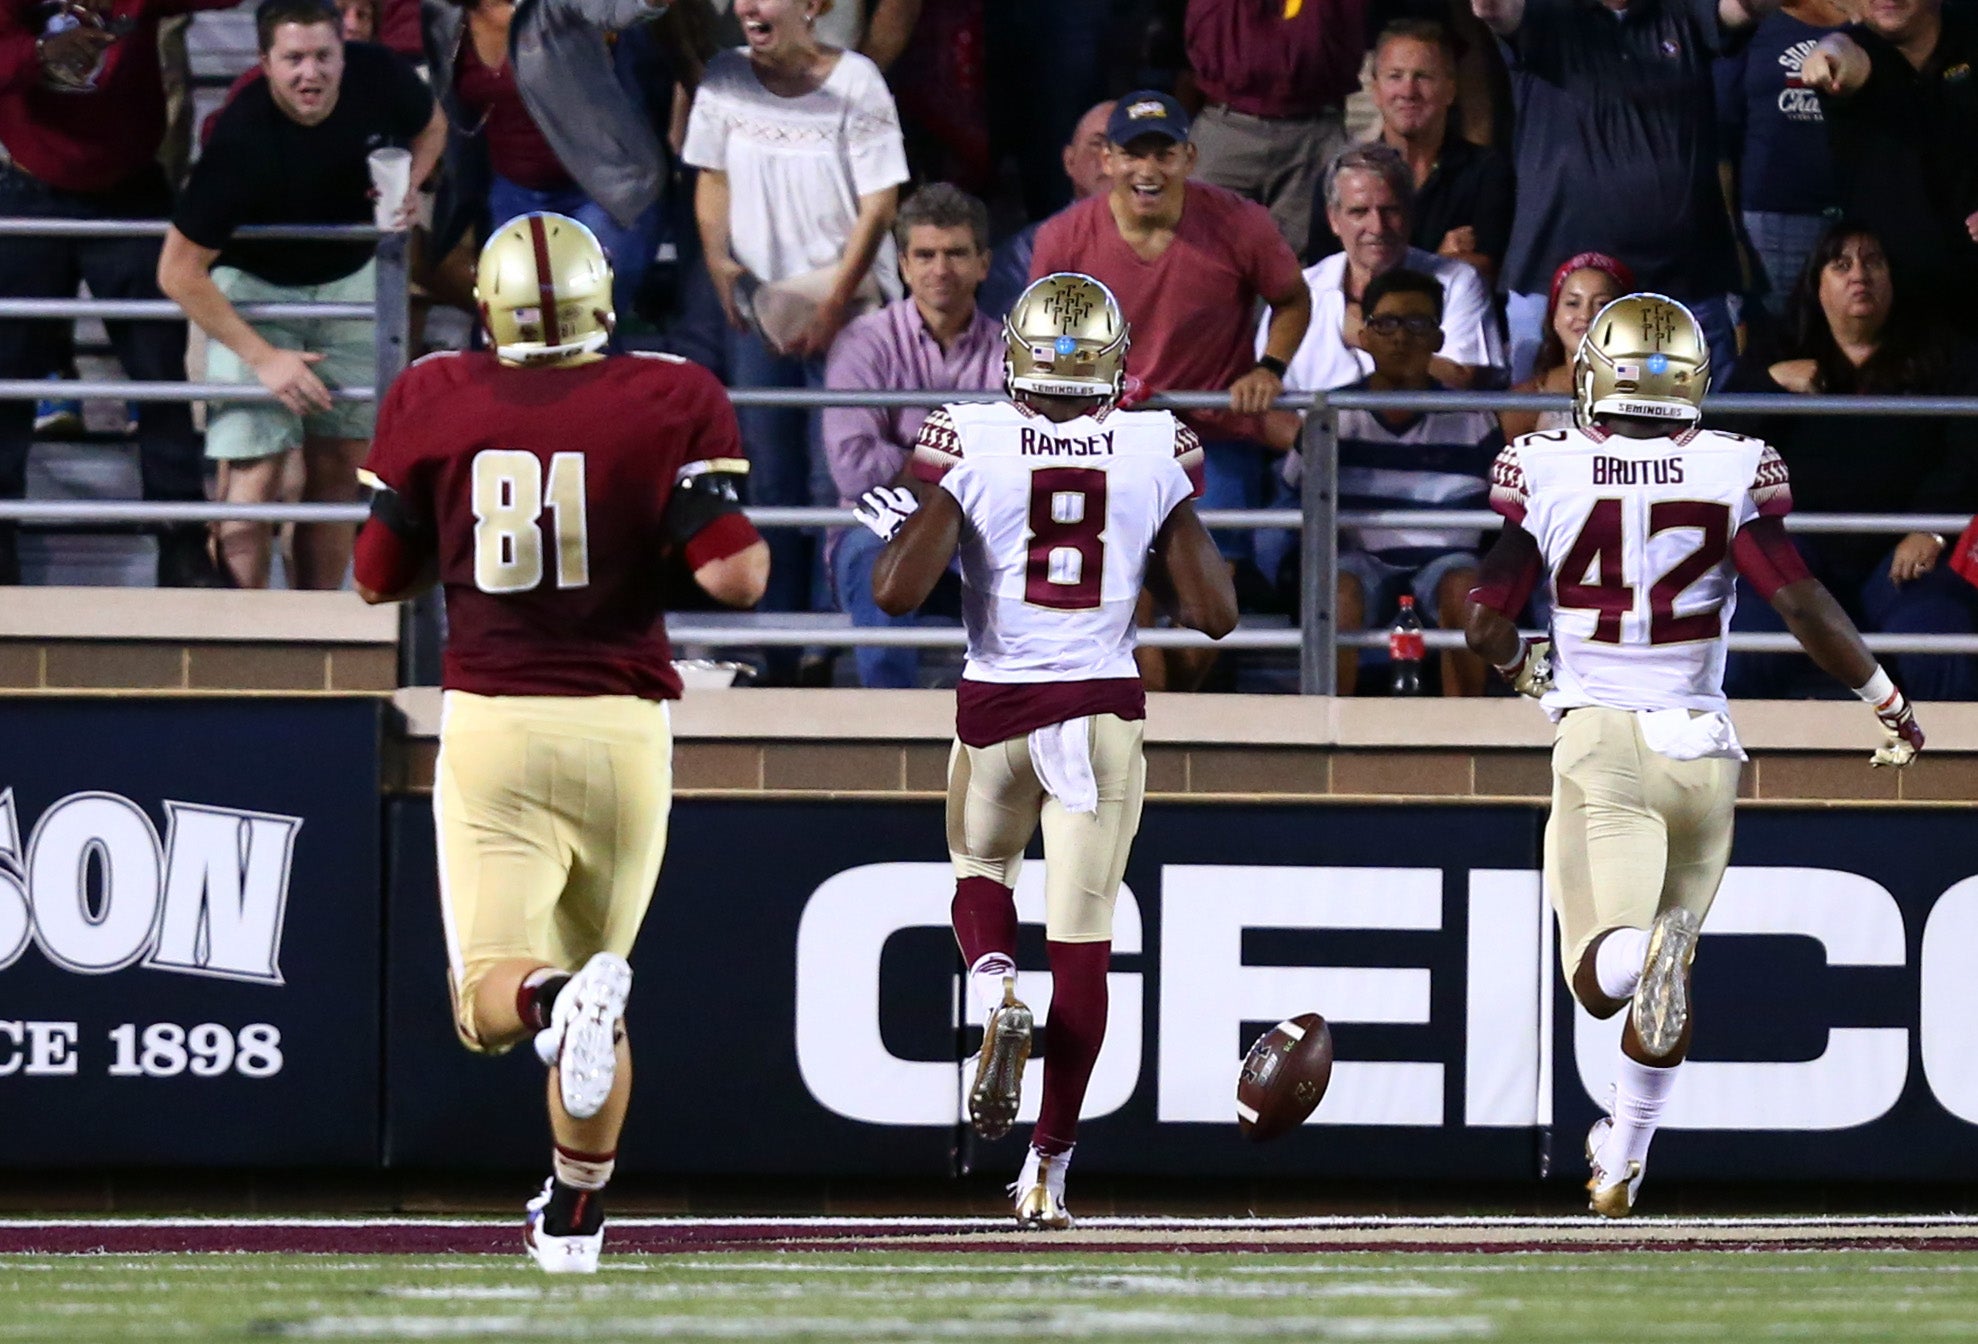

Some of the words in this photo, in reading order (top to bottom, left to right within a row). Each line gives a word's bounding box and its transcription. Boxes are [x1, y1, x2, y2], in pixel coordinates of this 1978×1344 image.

[1031, 383, 1095, 395] SEMINOLES
[1618, 402, 1683, 418] SEMINOLES
[1021, 426, 1115, 457] RAMSEY
[1593, 455, 1684, 485] BRUTUS
[472, 449, 590, 594] 81
[1023, 466, 1109, 613] 8
[1555, 496, 1733, 646] 42
[0, 786, 304, 987] ON
[795, 861, 1978, 1131] GEIC
[108, 1021, 284, 1078] 1898
